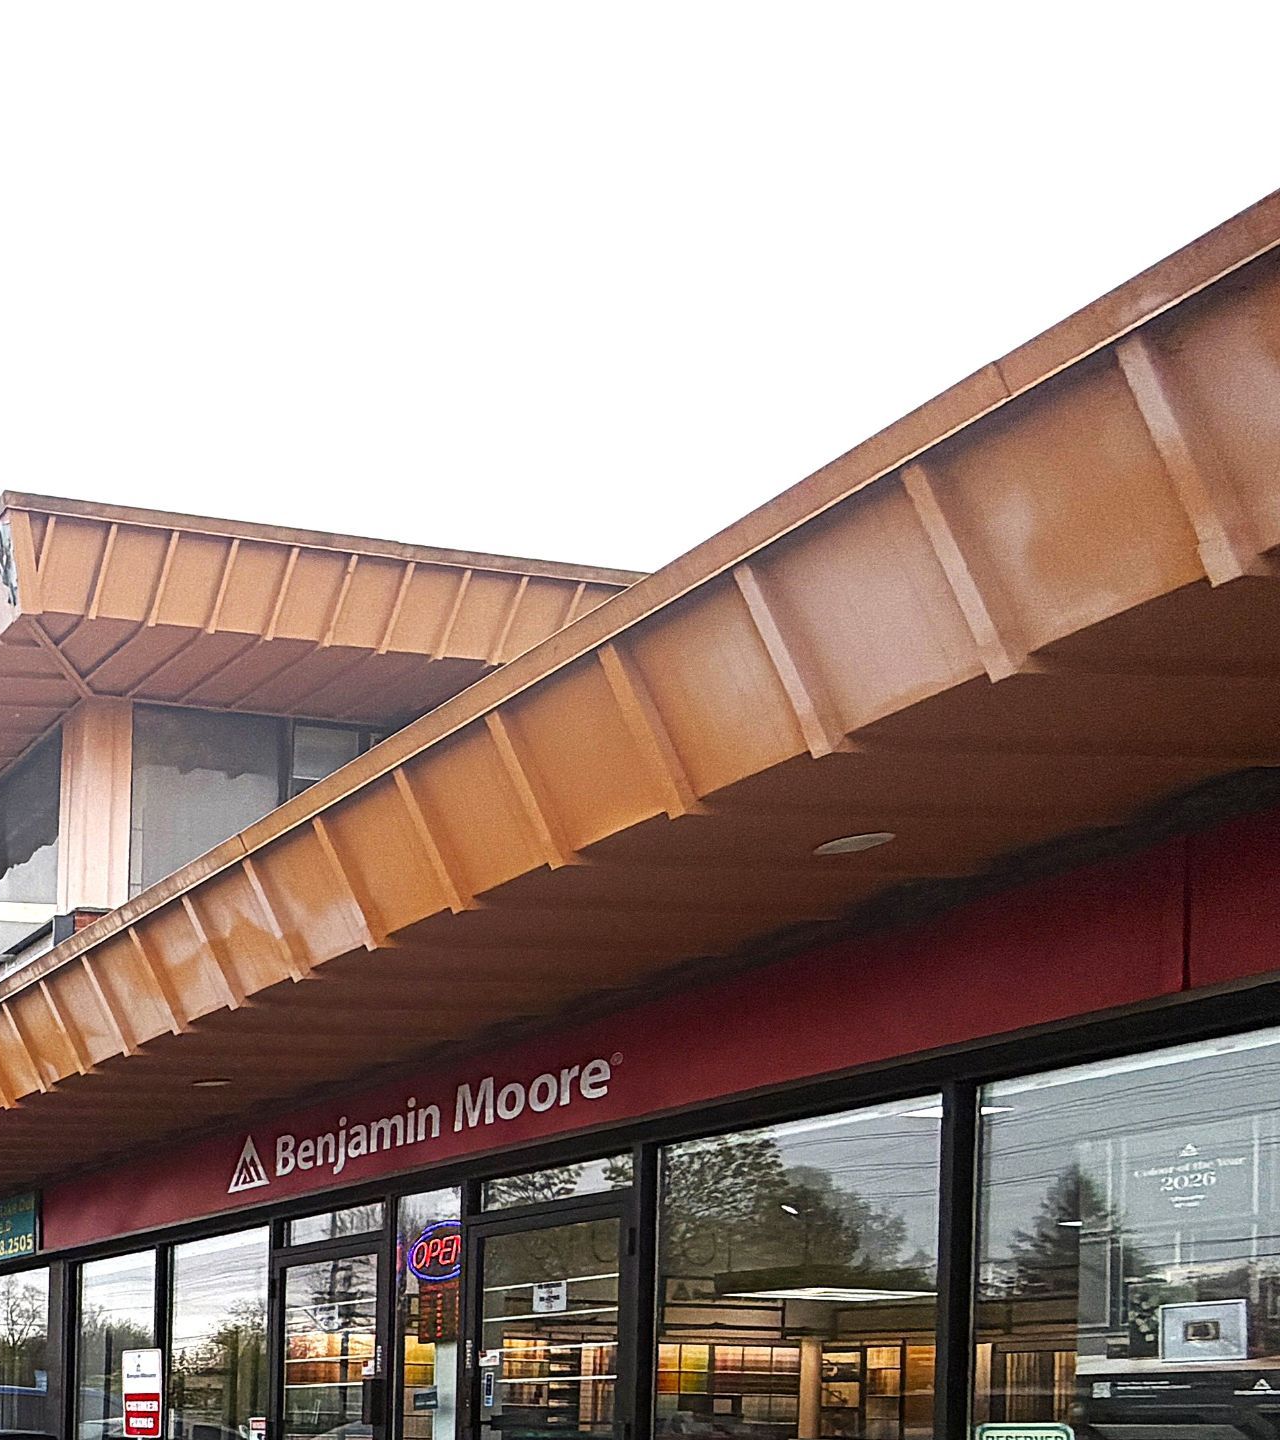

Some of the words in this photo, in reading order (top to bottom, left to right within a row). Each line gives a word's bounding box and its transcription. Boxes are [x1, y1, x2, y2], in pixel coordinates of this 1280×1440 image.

[275, 1097, 441, 1176] Benjamin
[453, 1058, 611, 1133] Moore
[1160, 1171, 1217, 1192] 2026
